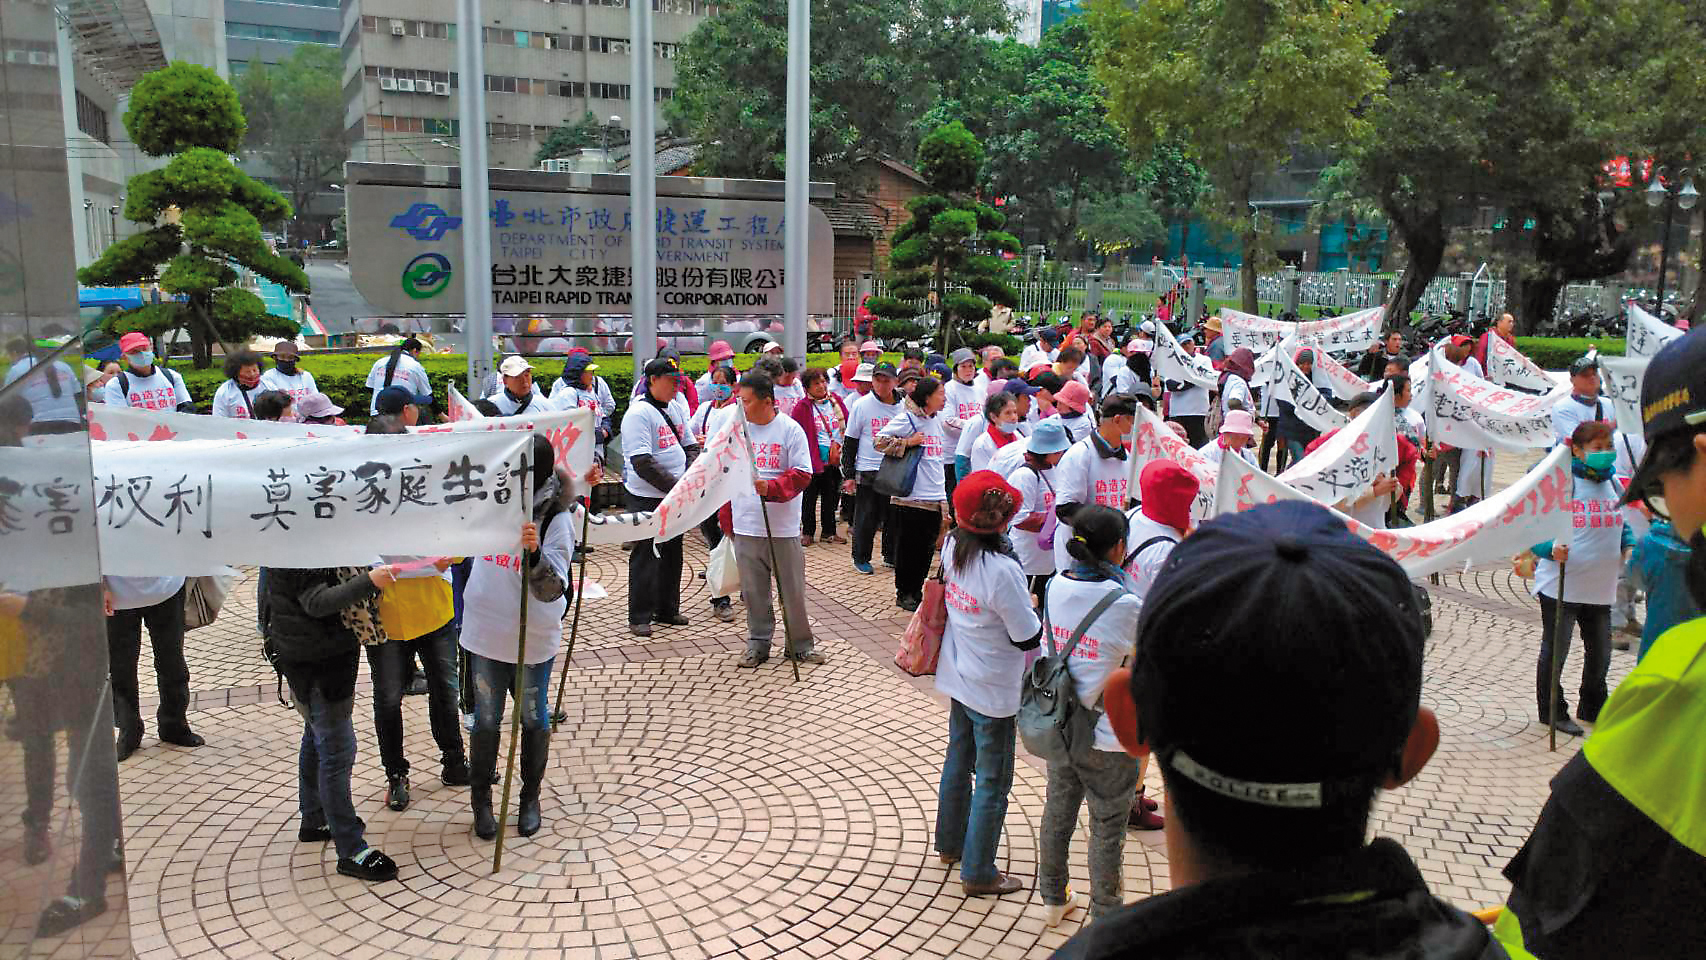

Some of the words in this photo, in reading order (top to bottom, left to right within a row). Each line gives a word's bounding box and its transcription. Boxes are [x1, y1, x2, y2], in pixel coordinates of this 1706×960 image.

[489, 199, 785, 237] 臺北市政捷運工程
[500, 232, 595, 247] DEPARTMENT
[605, 235, 623, 247] OF
[681, 237, 733, 249] TRANSIT
[742, 239, 785, 251] SYSTEM
[502, 246, 543, 260] TAIPEI
[569, 248, 607, 260] CITY
[656, 250, 729, 262] VERNMENT
[491, 263, 785, 290] 台北大衆捷股份有限公
[492, 290, 541, 304] TAIPEI
[545, 291, 592, 305] RAPID
[664, 291, 767, 306] CORPORATION
